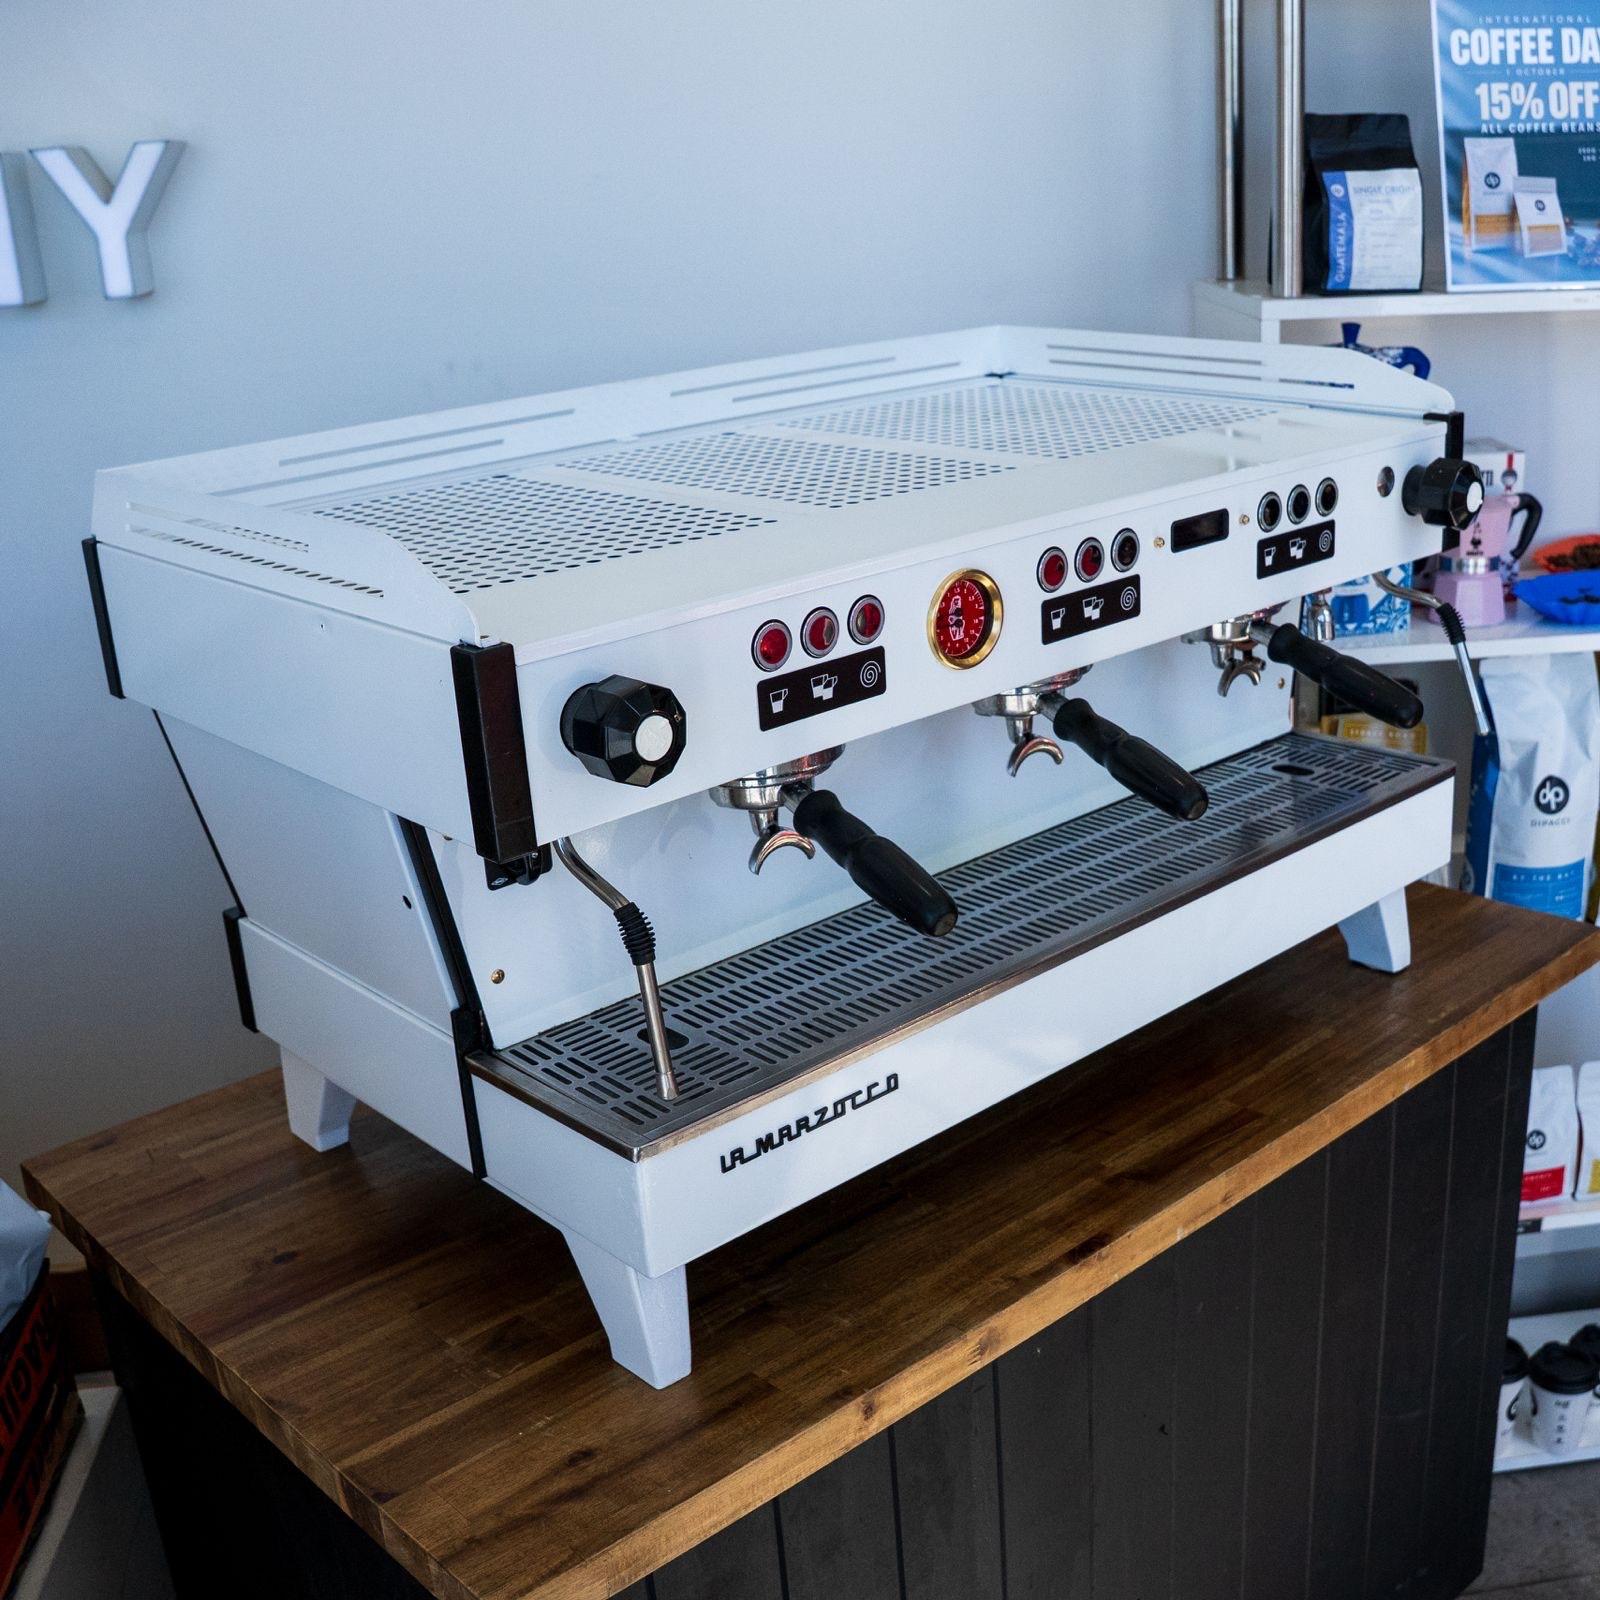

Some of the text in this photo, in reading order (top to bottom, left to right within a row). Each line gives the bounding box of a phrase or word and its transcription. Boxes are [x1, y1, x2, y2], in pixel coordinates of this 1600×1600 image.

[1479, 15, 1592, 25] INTERNATIONAL
[1450, 27, 1555, 66] COFFEE
[1516, 67, 1565, 77] OCTOBER
[1475, 80, 1600, 121] 15% OFF
[1481, 123, 1502, 134] ALL
[1509, 122, 1555, 134] COFFEE
[0, 139, 182, 307] Y
[720, 1073, 899, 1174] LA MARZOCCO
